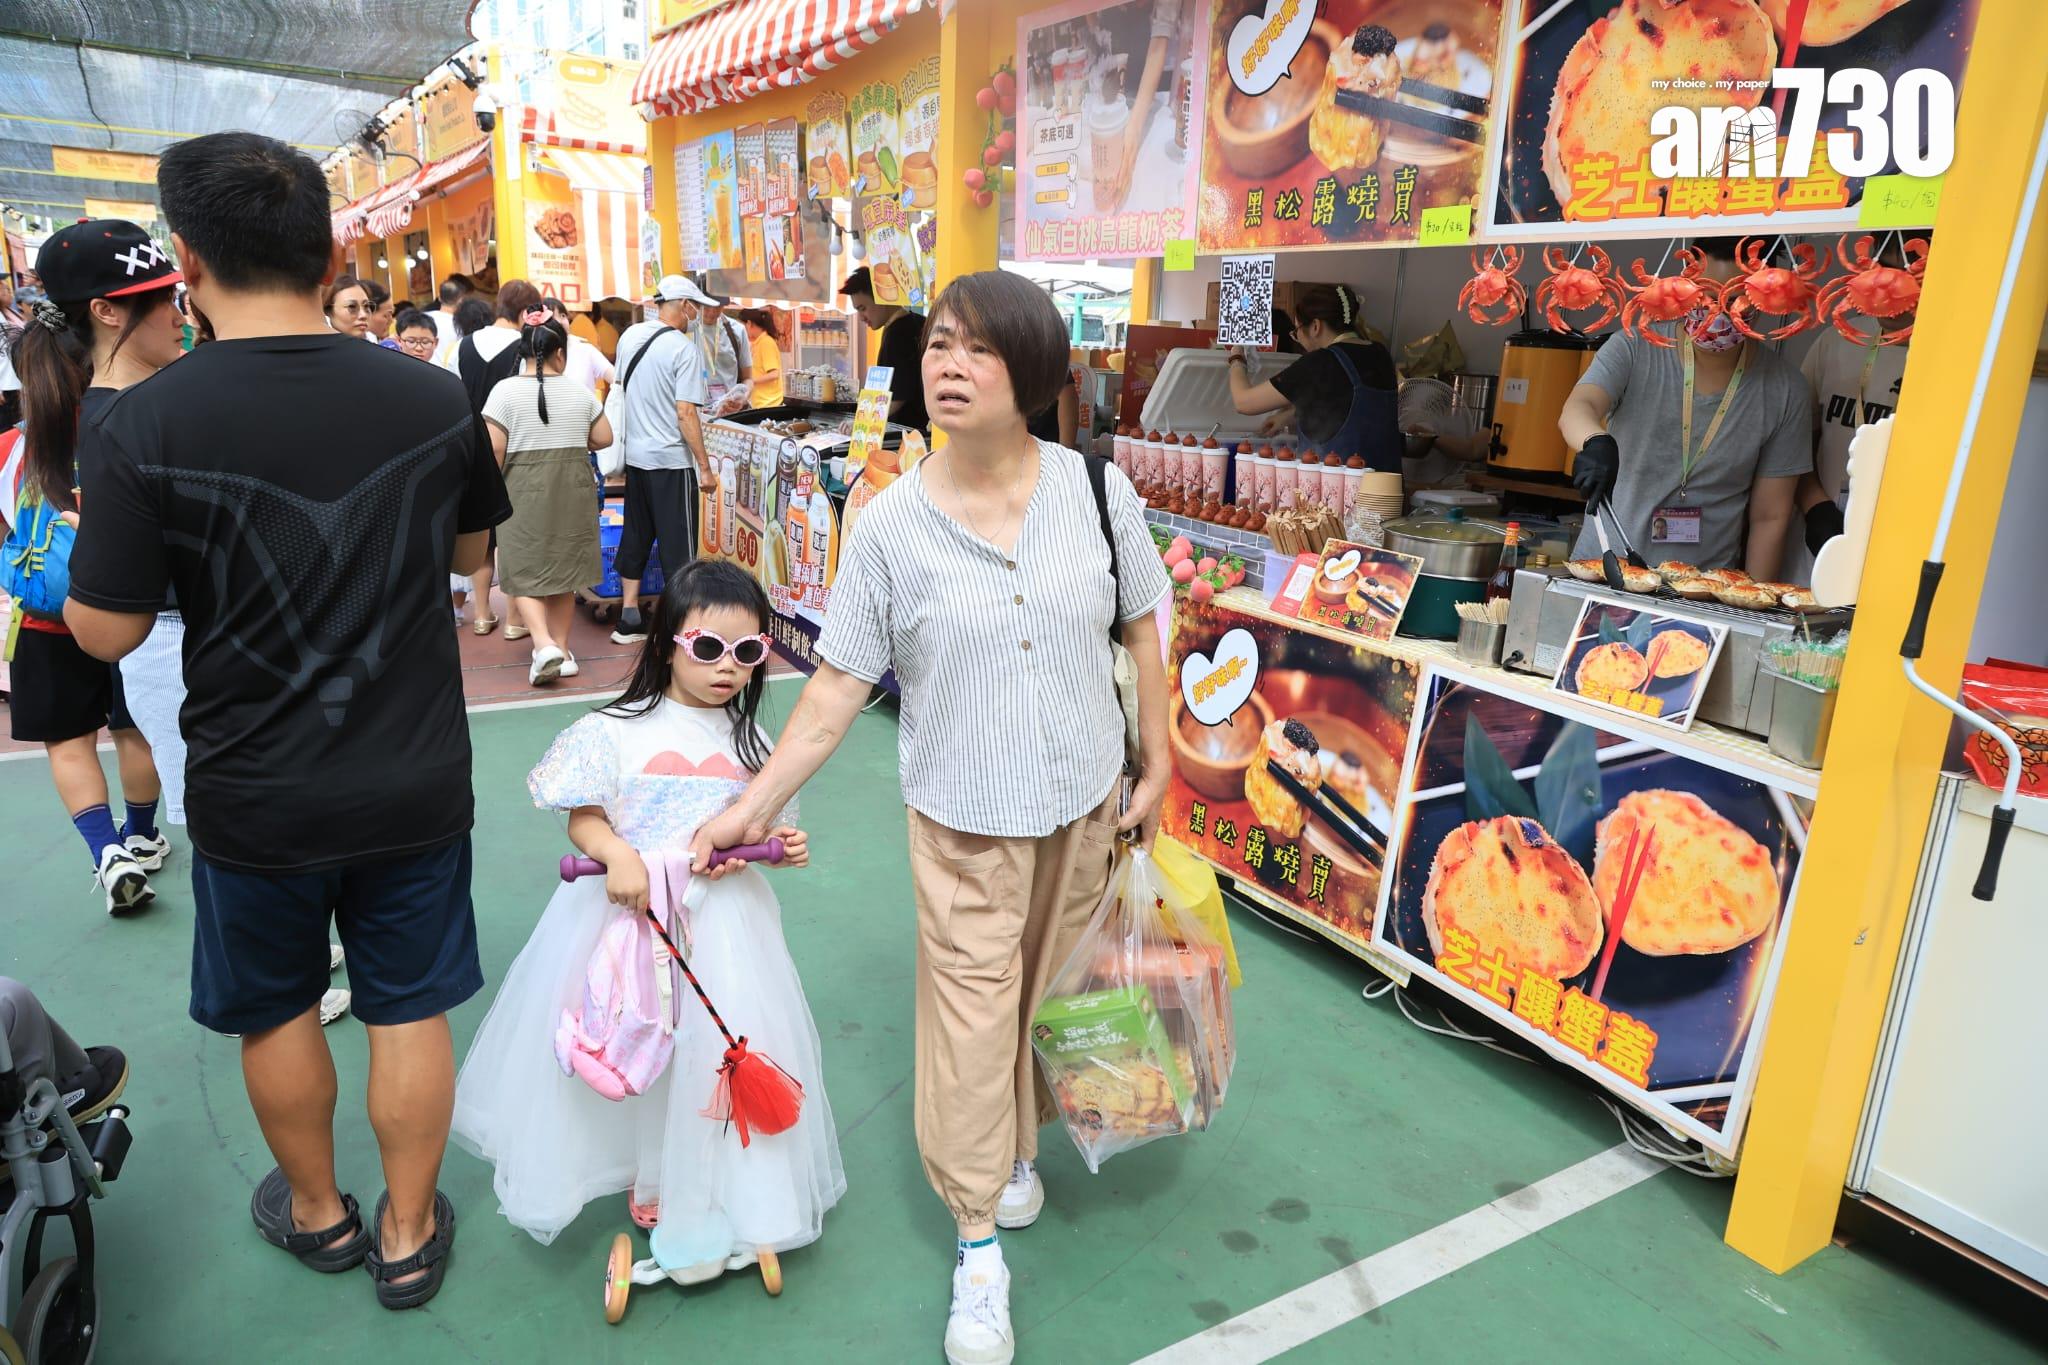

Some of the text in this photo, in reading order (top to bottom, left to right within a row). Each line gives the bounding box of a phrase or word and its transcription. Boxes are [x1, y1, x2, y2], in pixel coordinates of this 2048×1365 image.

[1040, 124, 1074, 144] 茶底可選
[1245, 164, 1418, 228] 黑松露燒賣
[1025, 208, 1184, 256] 仙氣白桃烏龍奶茶
[1826, 394, 1894, 428] PUM
[1190, 800, 1332, 903] 黑松露燒賣
[1435, 926, 1658, 1091] 芝士釀蟹蓋
